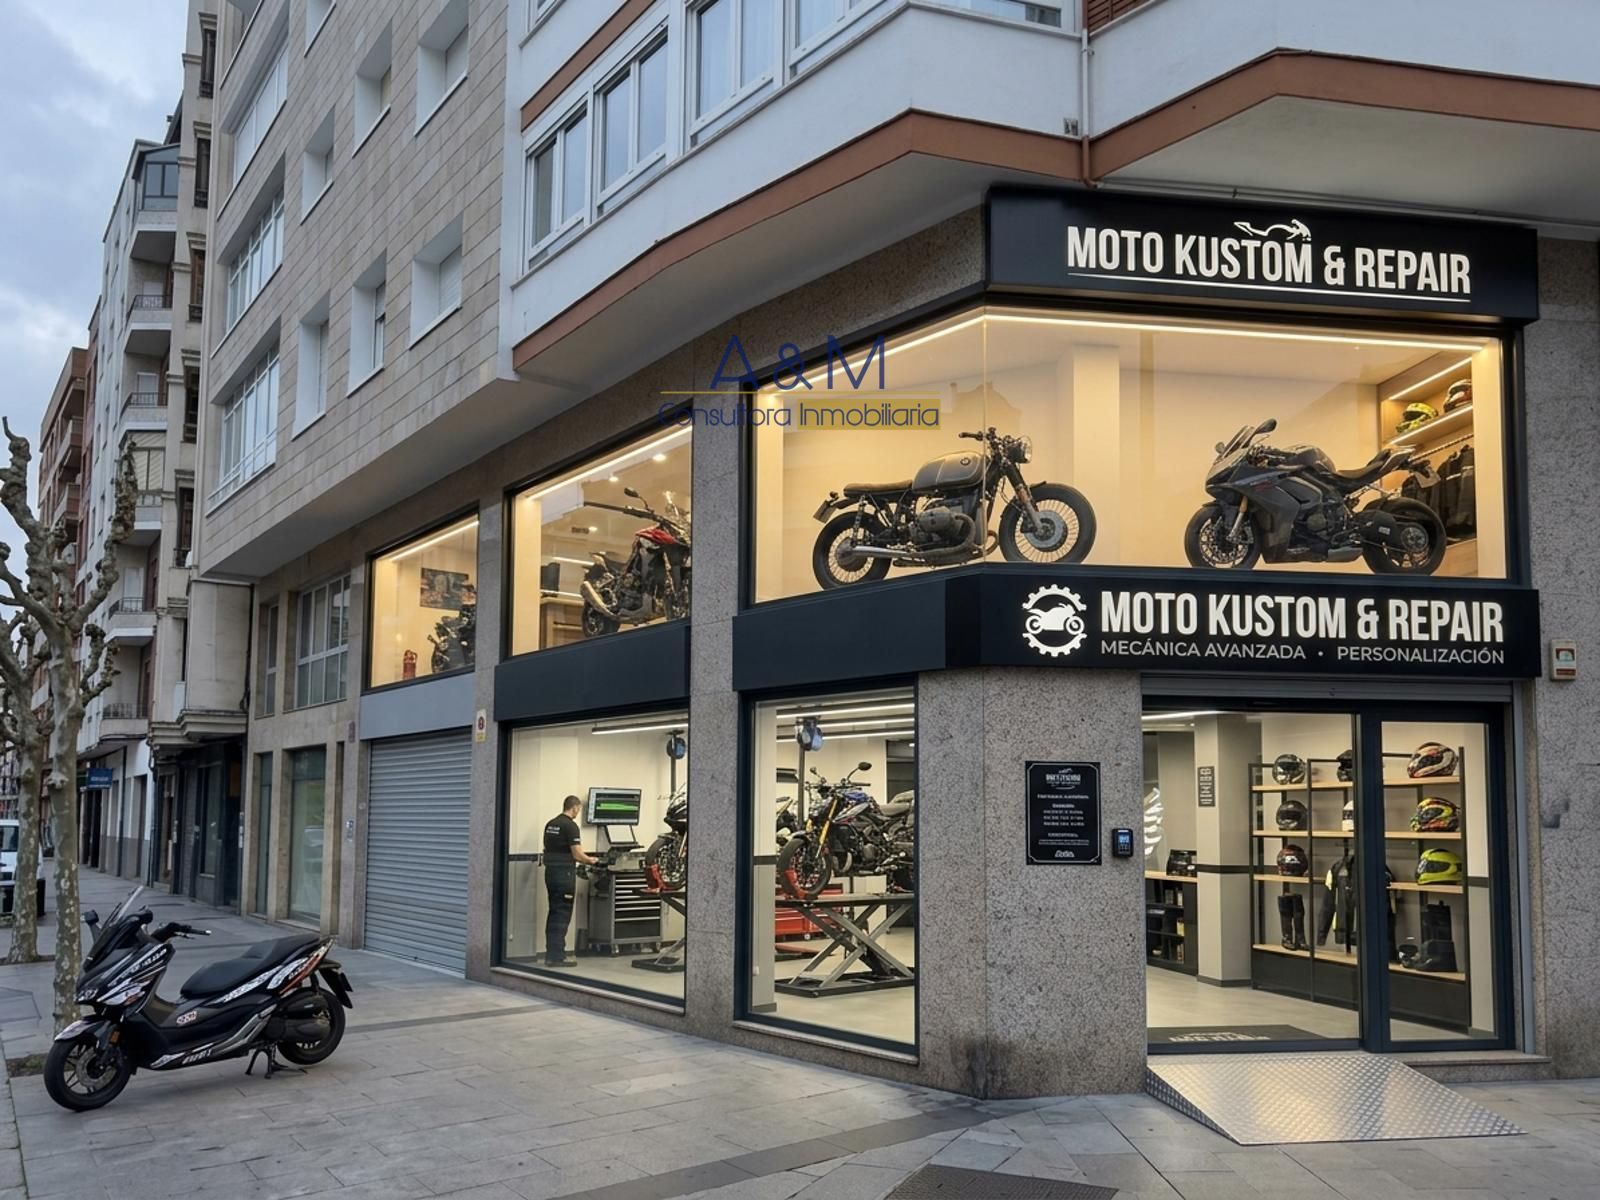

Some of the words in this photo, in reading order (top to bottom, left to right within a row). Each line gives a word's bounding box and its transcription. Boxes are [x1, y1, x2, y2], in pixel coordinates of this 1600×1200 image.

[1067, 226, 1164, 273] MOTO
[1175, 234, 1312, 283] KUSTOM
[1323, 246, 1346, 285] &
[1355, 247, 1471, 294] REPAIR
[1101, 591, 1198, 635] MOTO
[1209, 594, 1347, 639] KUSTOM
[1357, 601, 1380, 639] &
[1389, 600, 1504, 643] REPAIR
[1101, 638, 1201, 657] MECÁNICA
[1204, 643, 1306, 660] AVANZADA
[1337, 645, 1505, 664] PERSONALIZACIÓN
